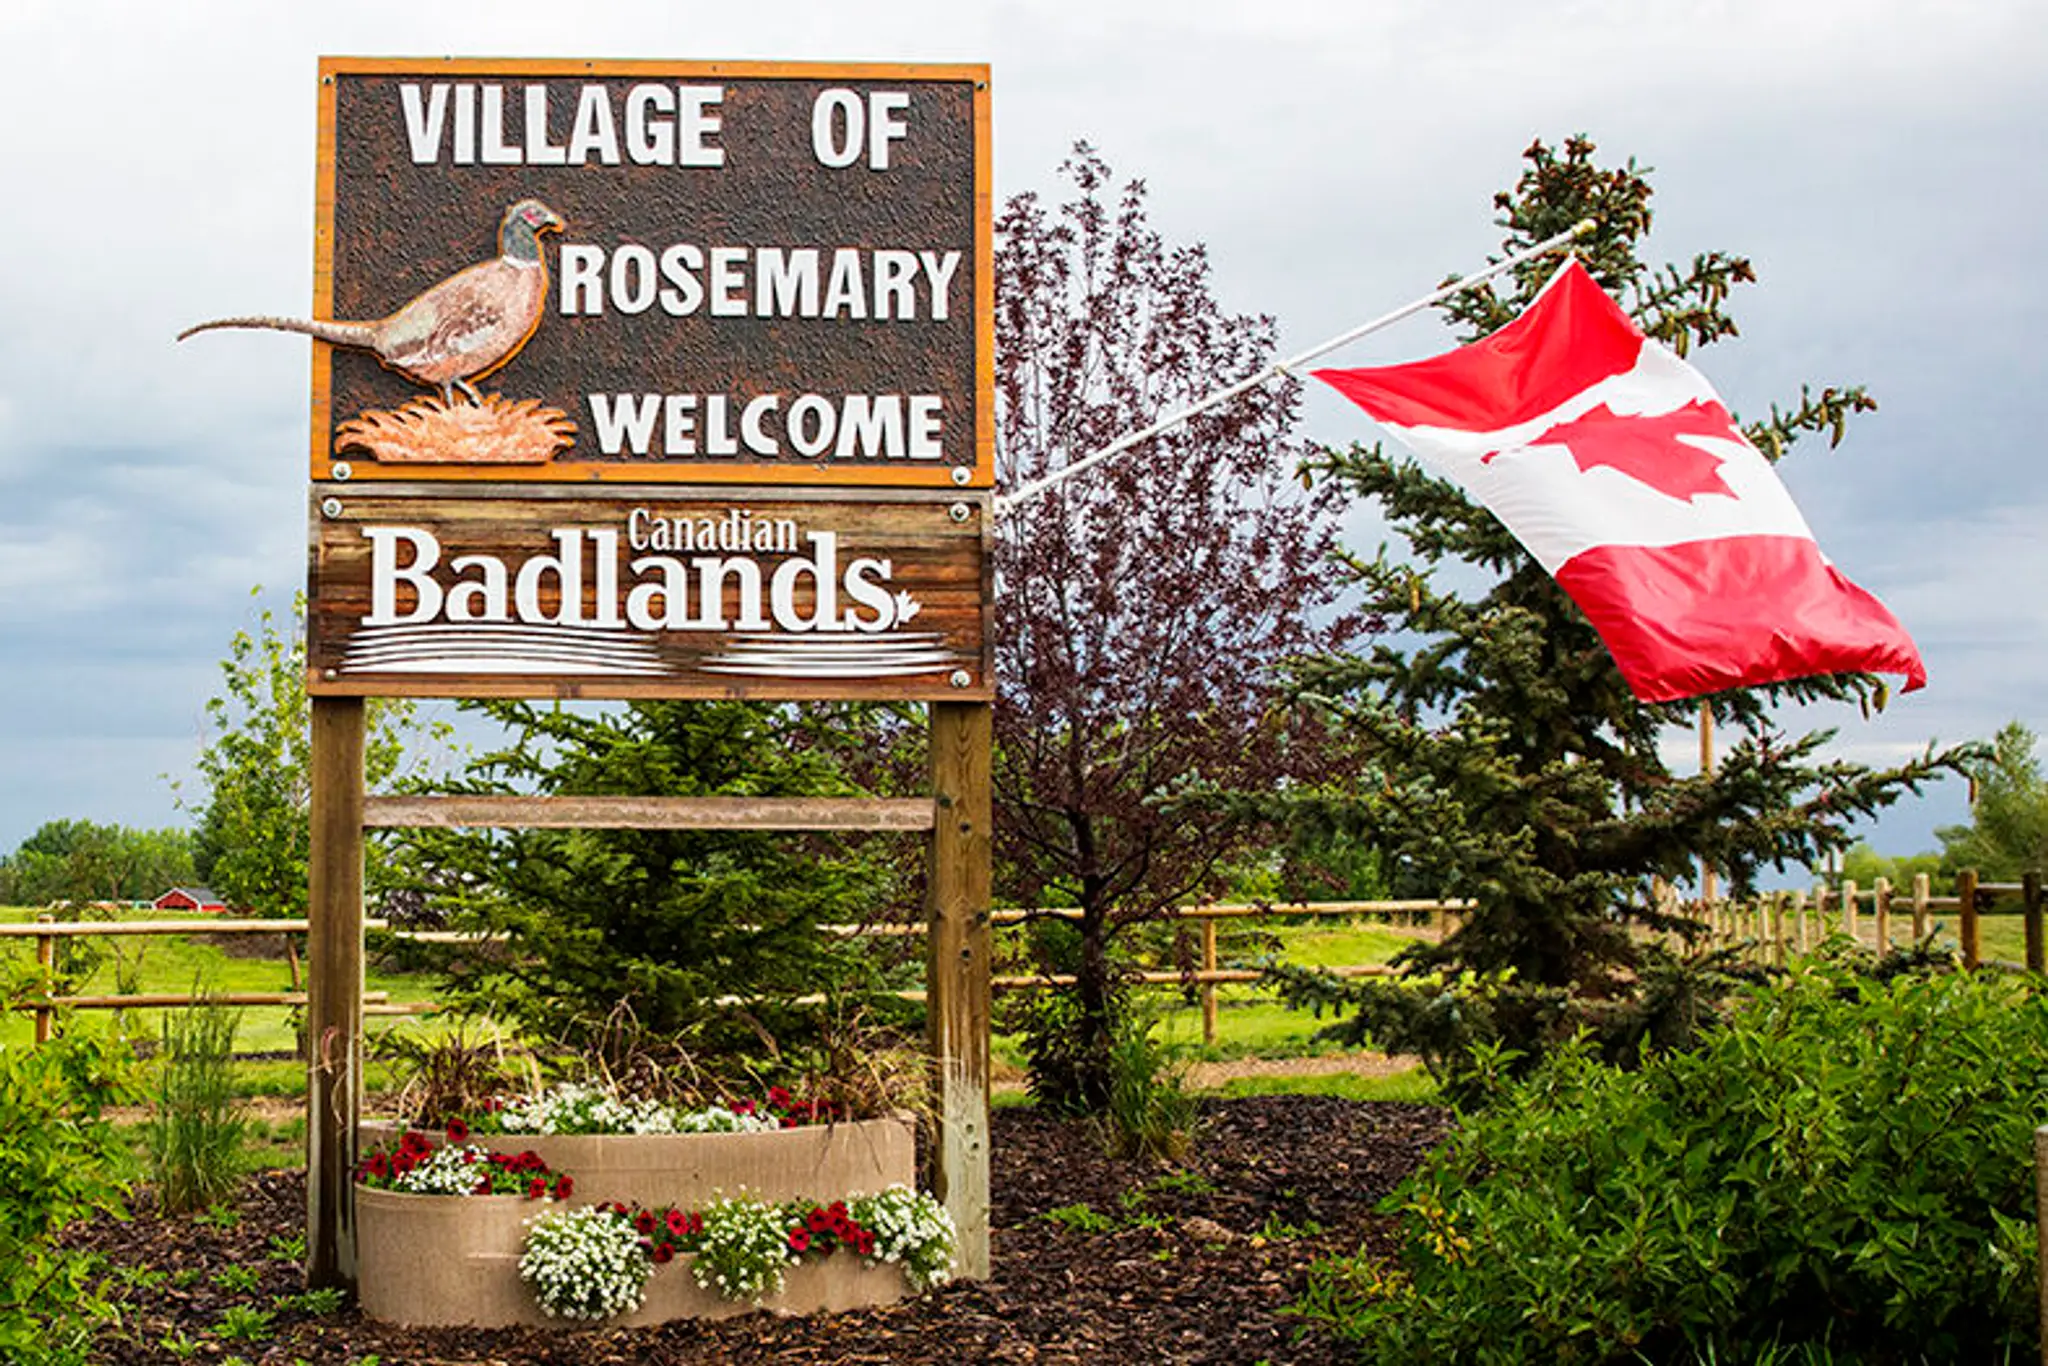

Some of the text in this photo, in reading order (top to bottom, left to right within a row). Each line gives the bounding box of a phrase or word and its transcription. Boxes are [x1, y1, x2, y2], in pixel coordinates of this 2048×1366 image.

[399, 83, 911, 170] VILLAGE OF
[559, 244, 962, 321] ROSEMARY
[588, 393, 944, 459] WELCOME
[628, 507, 799, 553] Canadian
[361, 526, 896, 634] Badlands
